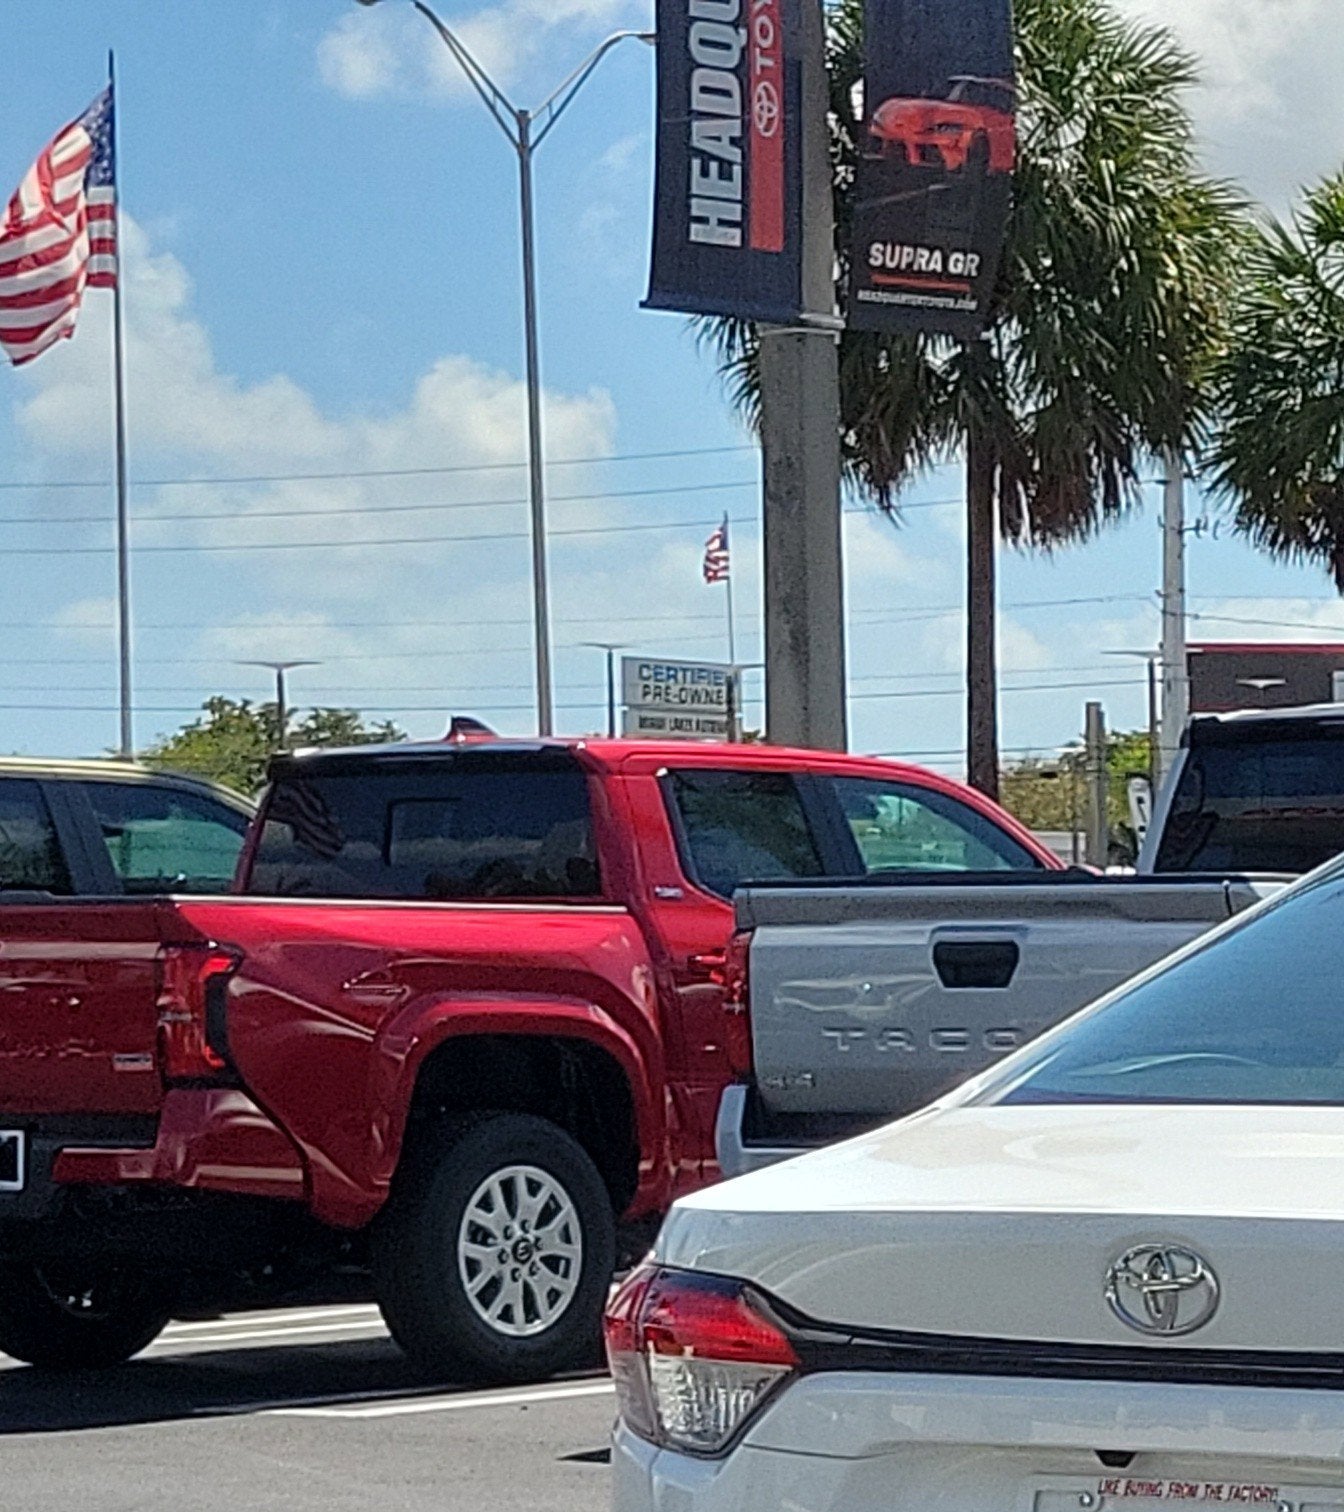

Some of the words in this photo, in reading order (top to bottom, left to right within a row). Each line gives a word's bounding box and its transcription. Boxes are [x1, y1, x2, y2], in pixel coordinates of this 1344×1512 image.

[869, 242, 943, 274] SUPRA
[947, 251, 980, 277] GR
[638, 663, 728, 688] CERTIFIE
[641, 683, 726, 706] PRE-OWNE
[821, 1026, 1021, 1053] TACO
[1166, 1481, 1200, 1500] FROM
[1202, 1483, 1223, 1501] THE
